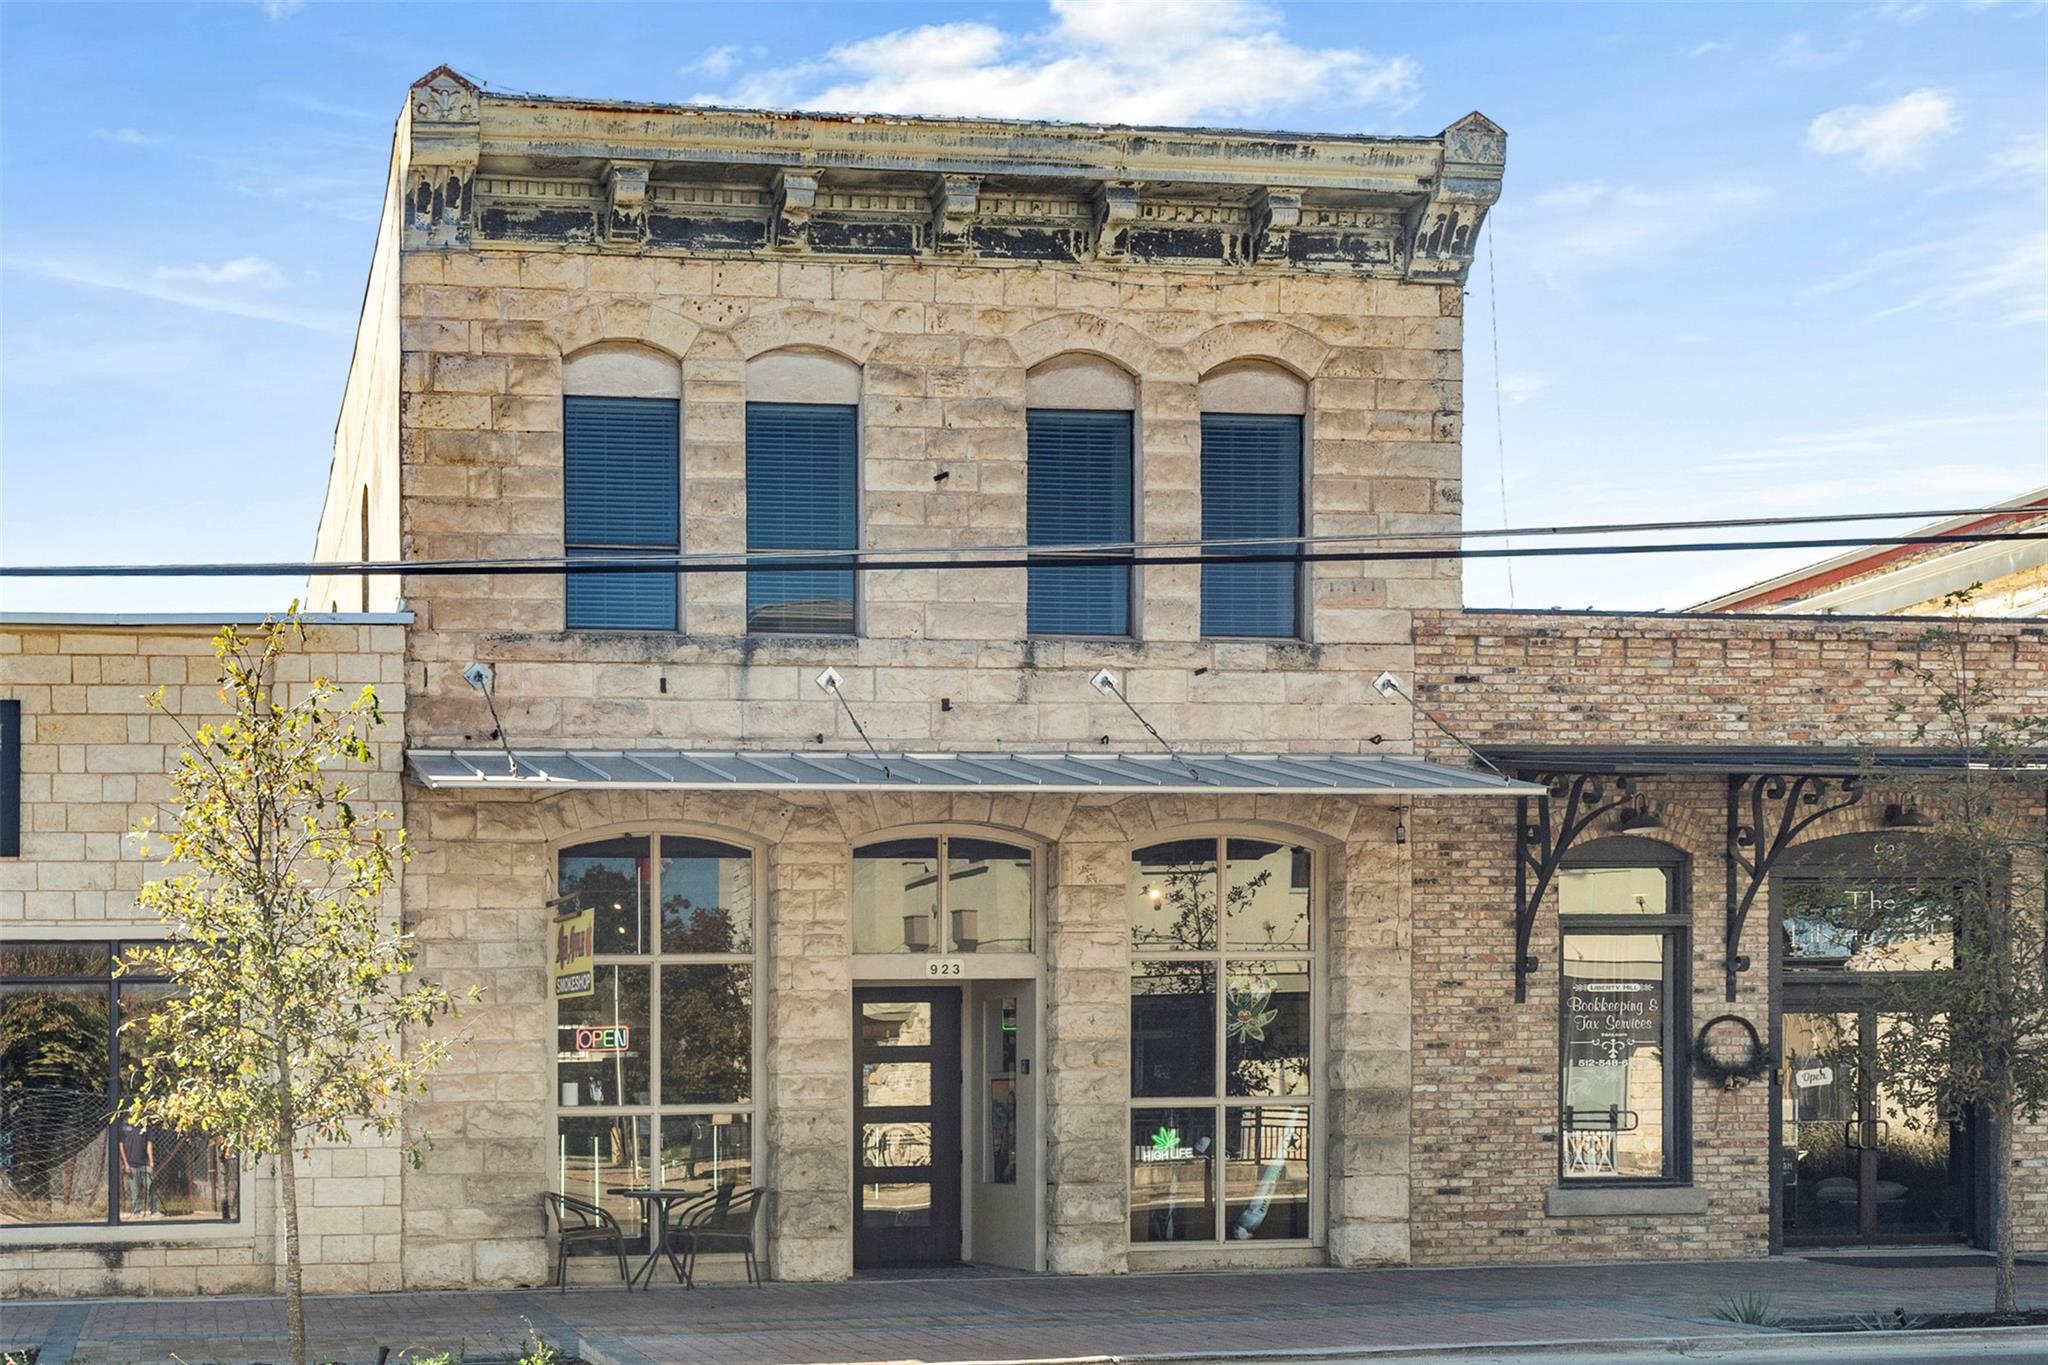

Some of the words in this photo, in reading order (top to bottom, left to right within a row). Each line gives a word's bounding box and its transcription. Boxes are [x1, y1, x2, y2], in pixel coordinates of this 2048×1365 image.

[1844, 890, 1896, 910] The
[930, 963, 960, 975] 923
[556, 973, 591, 994] SMOKESHOP
[1567, 996, 1643, 1015] Bookkeeping
[1648, 998, 1658, 1011] &
[1574, 1015, 1600, 1031] Tax
[1605, 1015, 1652, 1030] Services
[579, 1030, 626, 1047] OPEN
[1143, 1150, 1169, 1162] HIGH
[1170, 1147, 1193, 1159] LIFE
